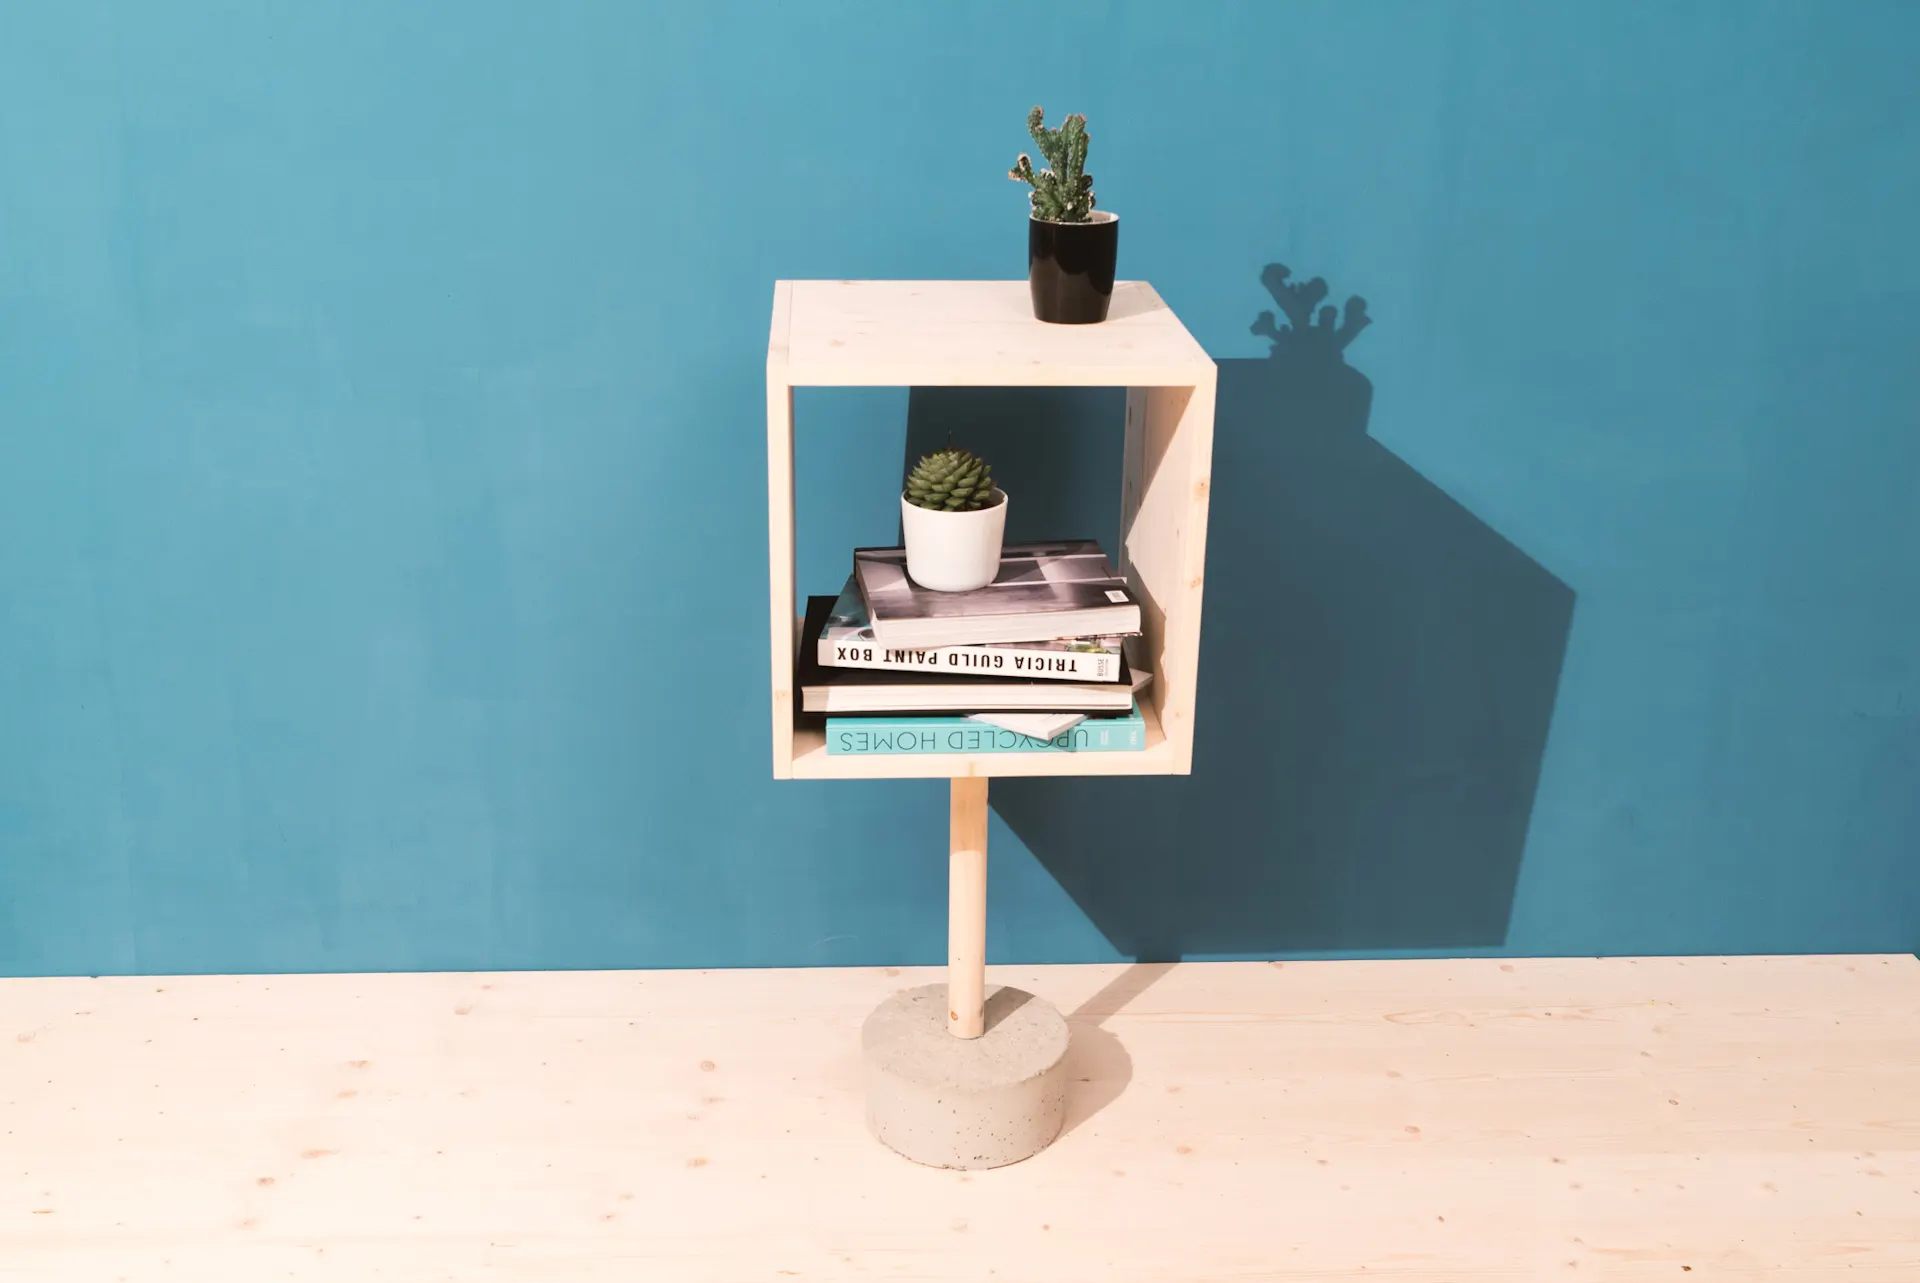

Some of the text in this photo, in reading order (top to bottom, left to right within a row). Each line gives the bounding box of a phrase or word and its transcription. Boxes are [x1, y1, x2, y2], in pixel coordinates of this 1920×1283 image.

[837, 646, 1078, 673] TRICIA GUILD PAINT BOX
[839, 731, 936, 752] HOMES
